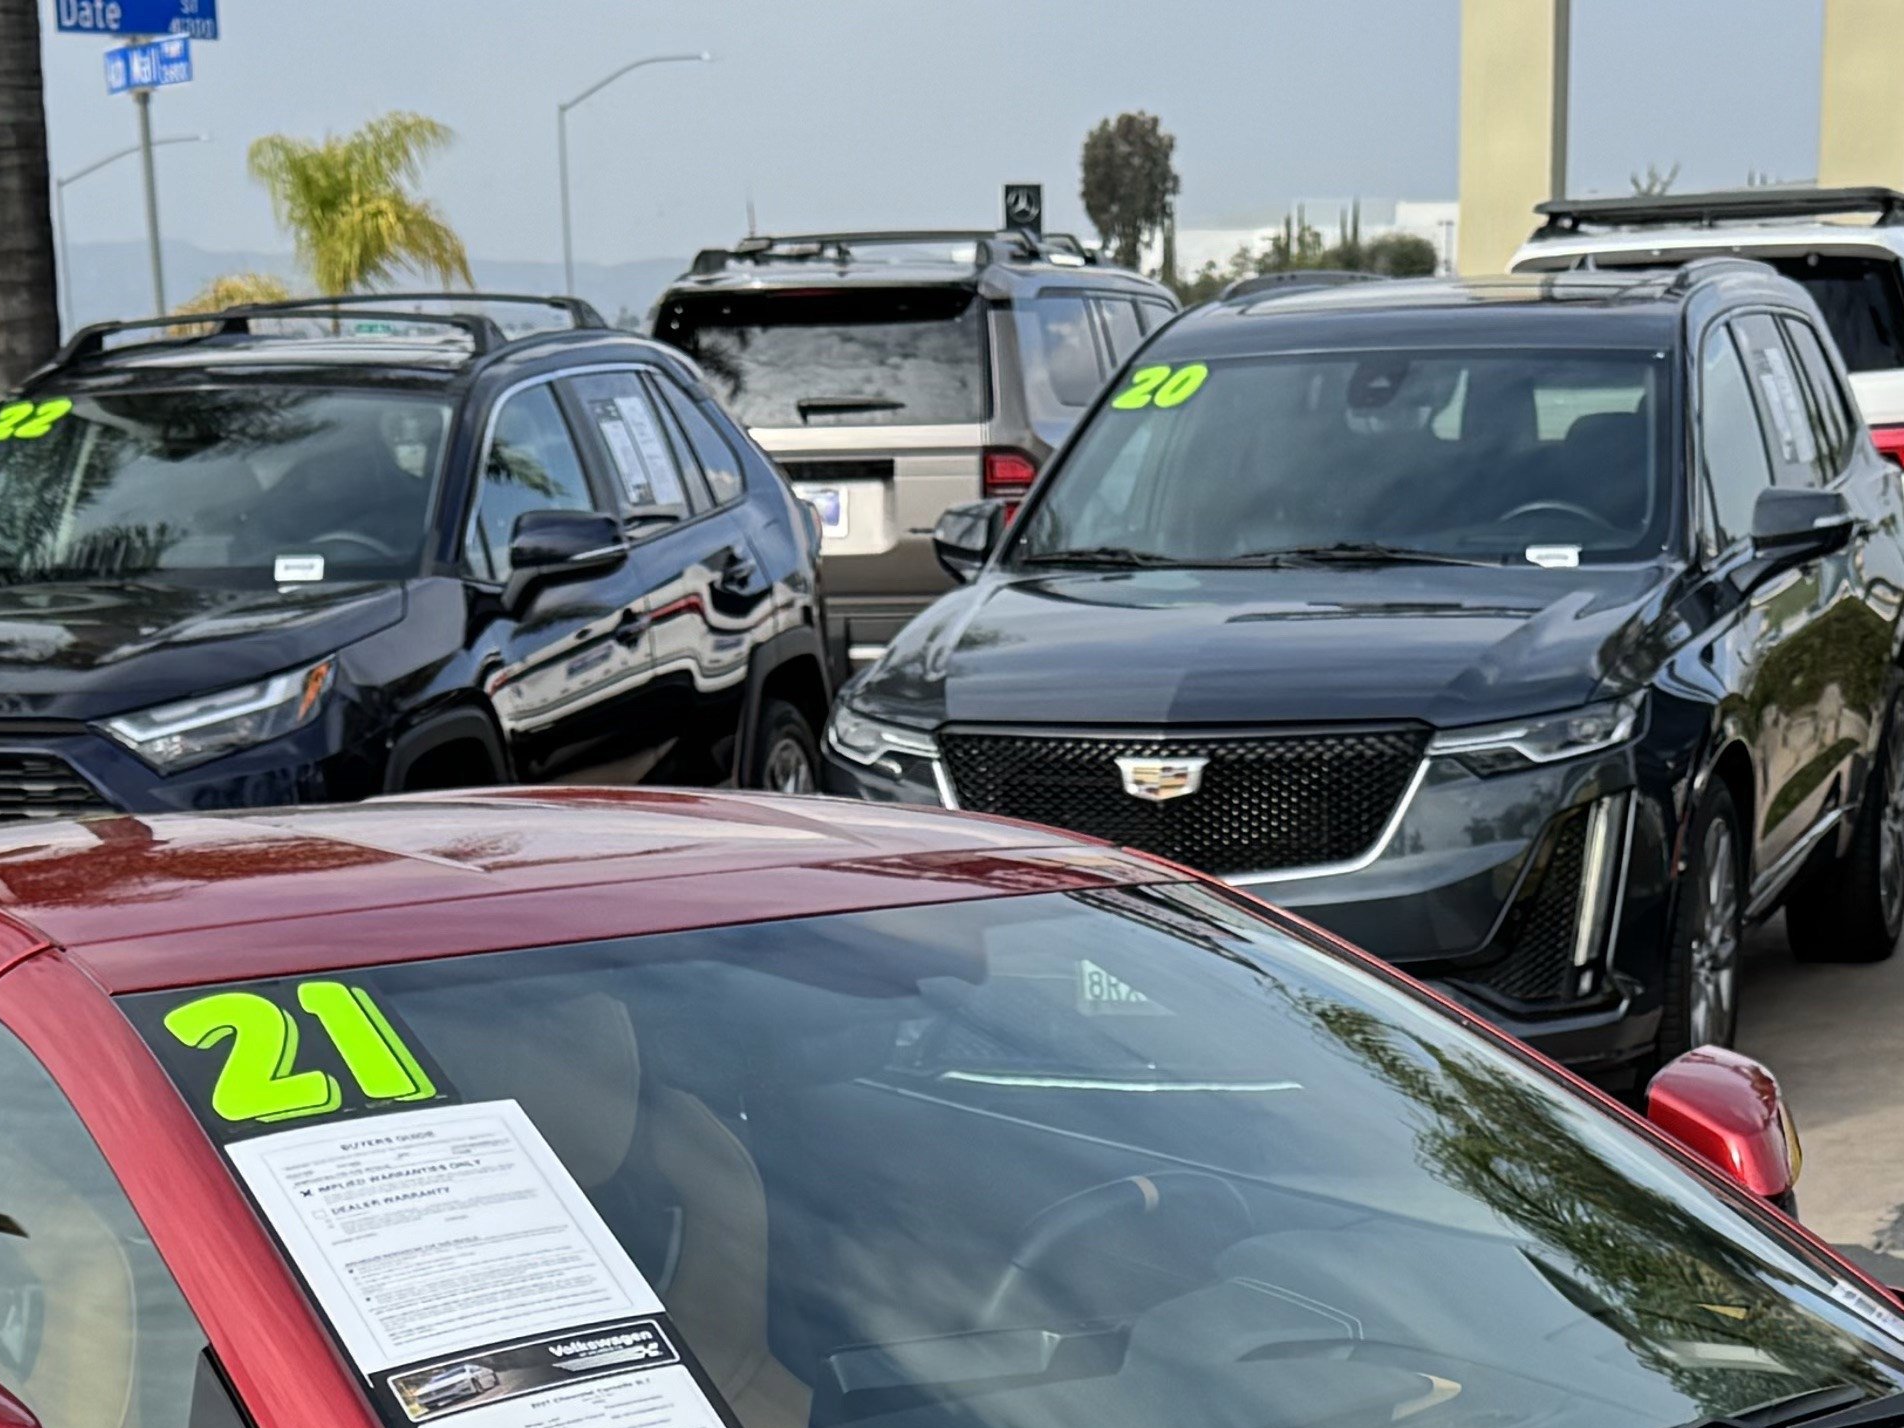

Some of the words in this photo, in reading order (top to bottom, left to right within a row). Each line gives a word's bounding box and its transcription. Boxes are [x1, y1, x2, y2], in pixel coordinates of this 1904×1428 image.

[59, 0, 122, 29] Date
[1111, 364, 1208, 409] 20
[164, 981, 437, 1123] 21
[339, 1136, 394, 1152] BUYERS
[317, 1175, 367, 1194] IMPLIED
[368, 1163, 448, 1183] WARRANTIES
[449, 1158, 482, 1170] ONLY
[330, 1199, 382, 1216] DEALER
[383, 1186, 451, 1204] WARRANTY
[548, 1330, 654, 1358] Volkswagen
